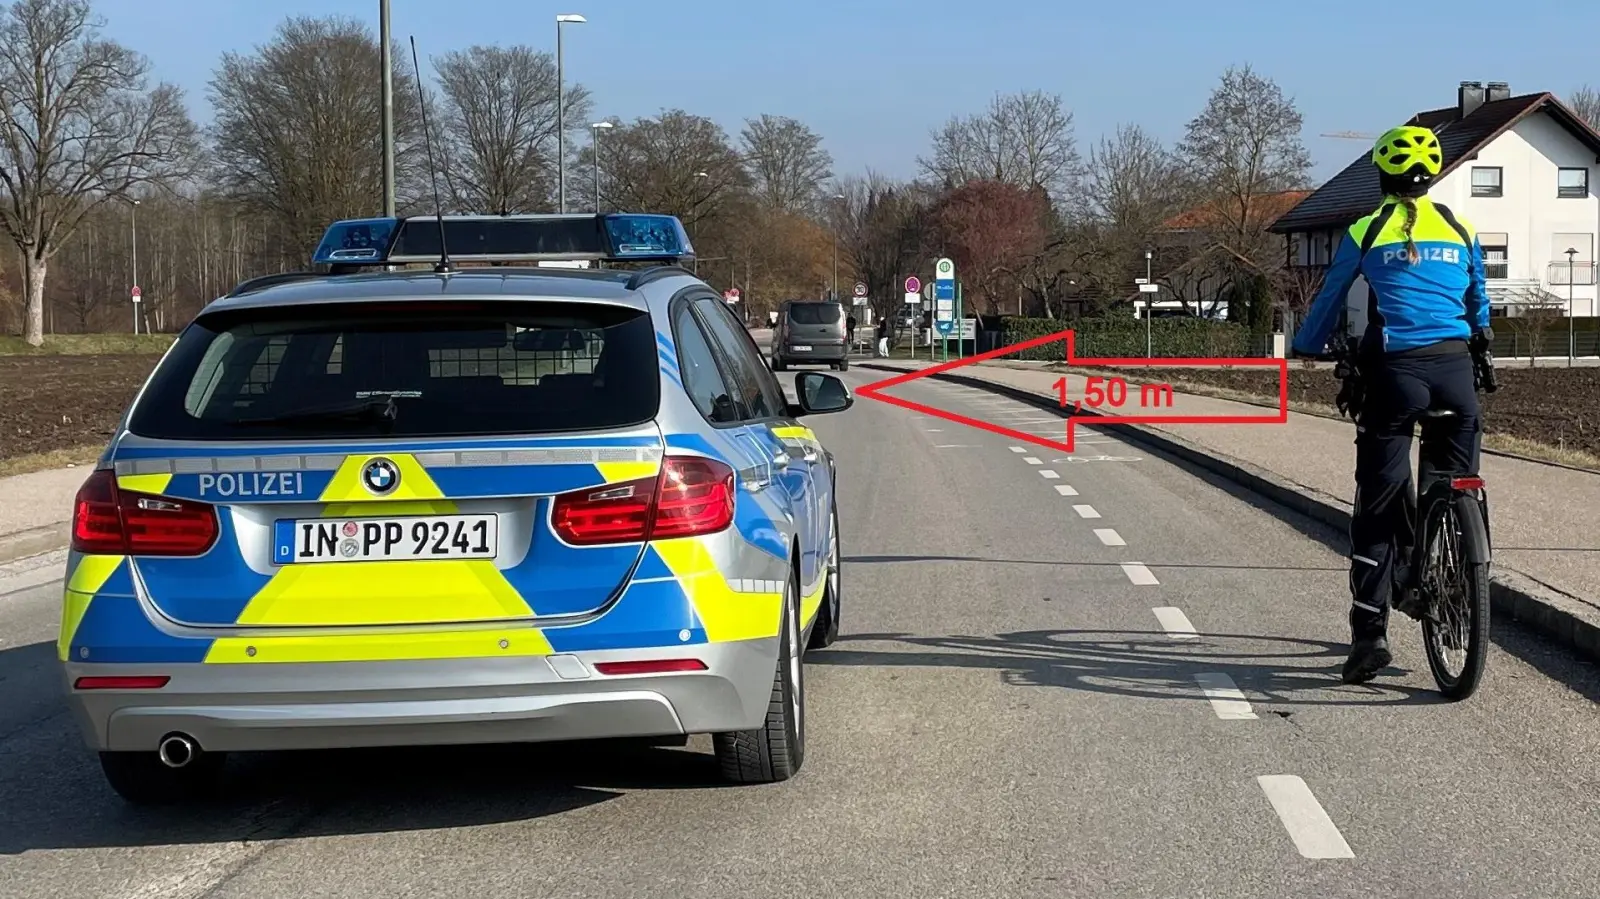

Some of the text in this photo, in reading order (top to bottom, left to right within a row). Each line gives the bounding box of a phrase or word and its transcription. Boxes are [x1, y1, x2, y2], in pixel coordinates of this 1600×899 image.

[1383, 248, 1459, 264] POIZEI
[199, 473, 302, 496] POLIZEI
[299, 520, 490, 557] IN PP 9241
[281, 546, 289, 555] D
